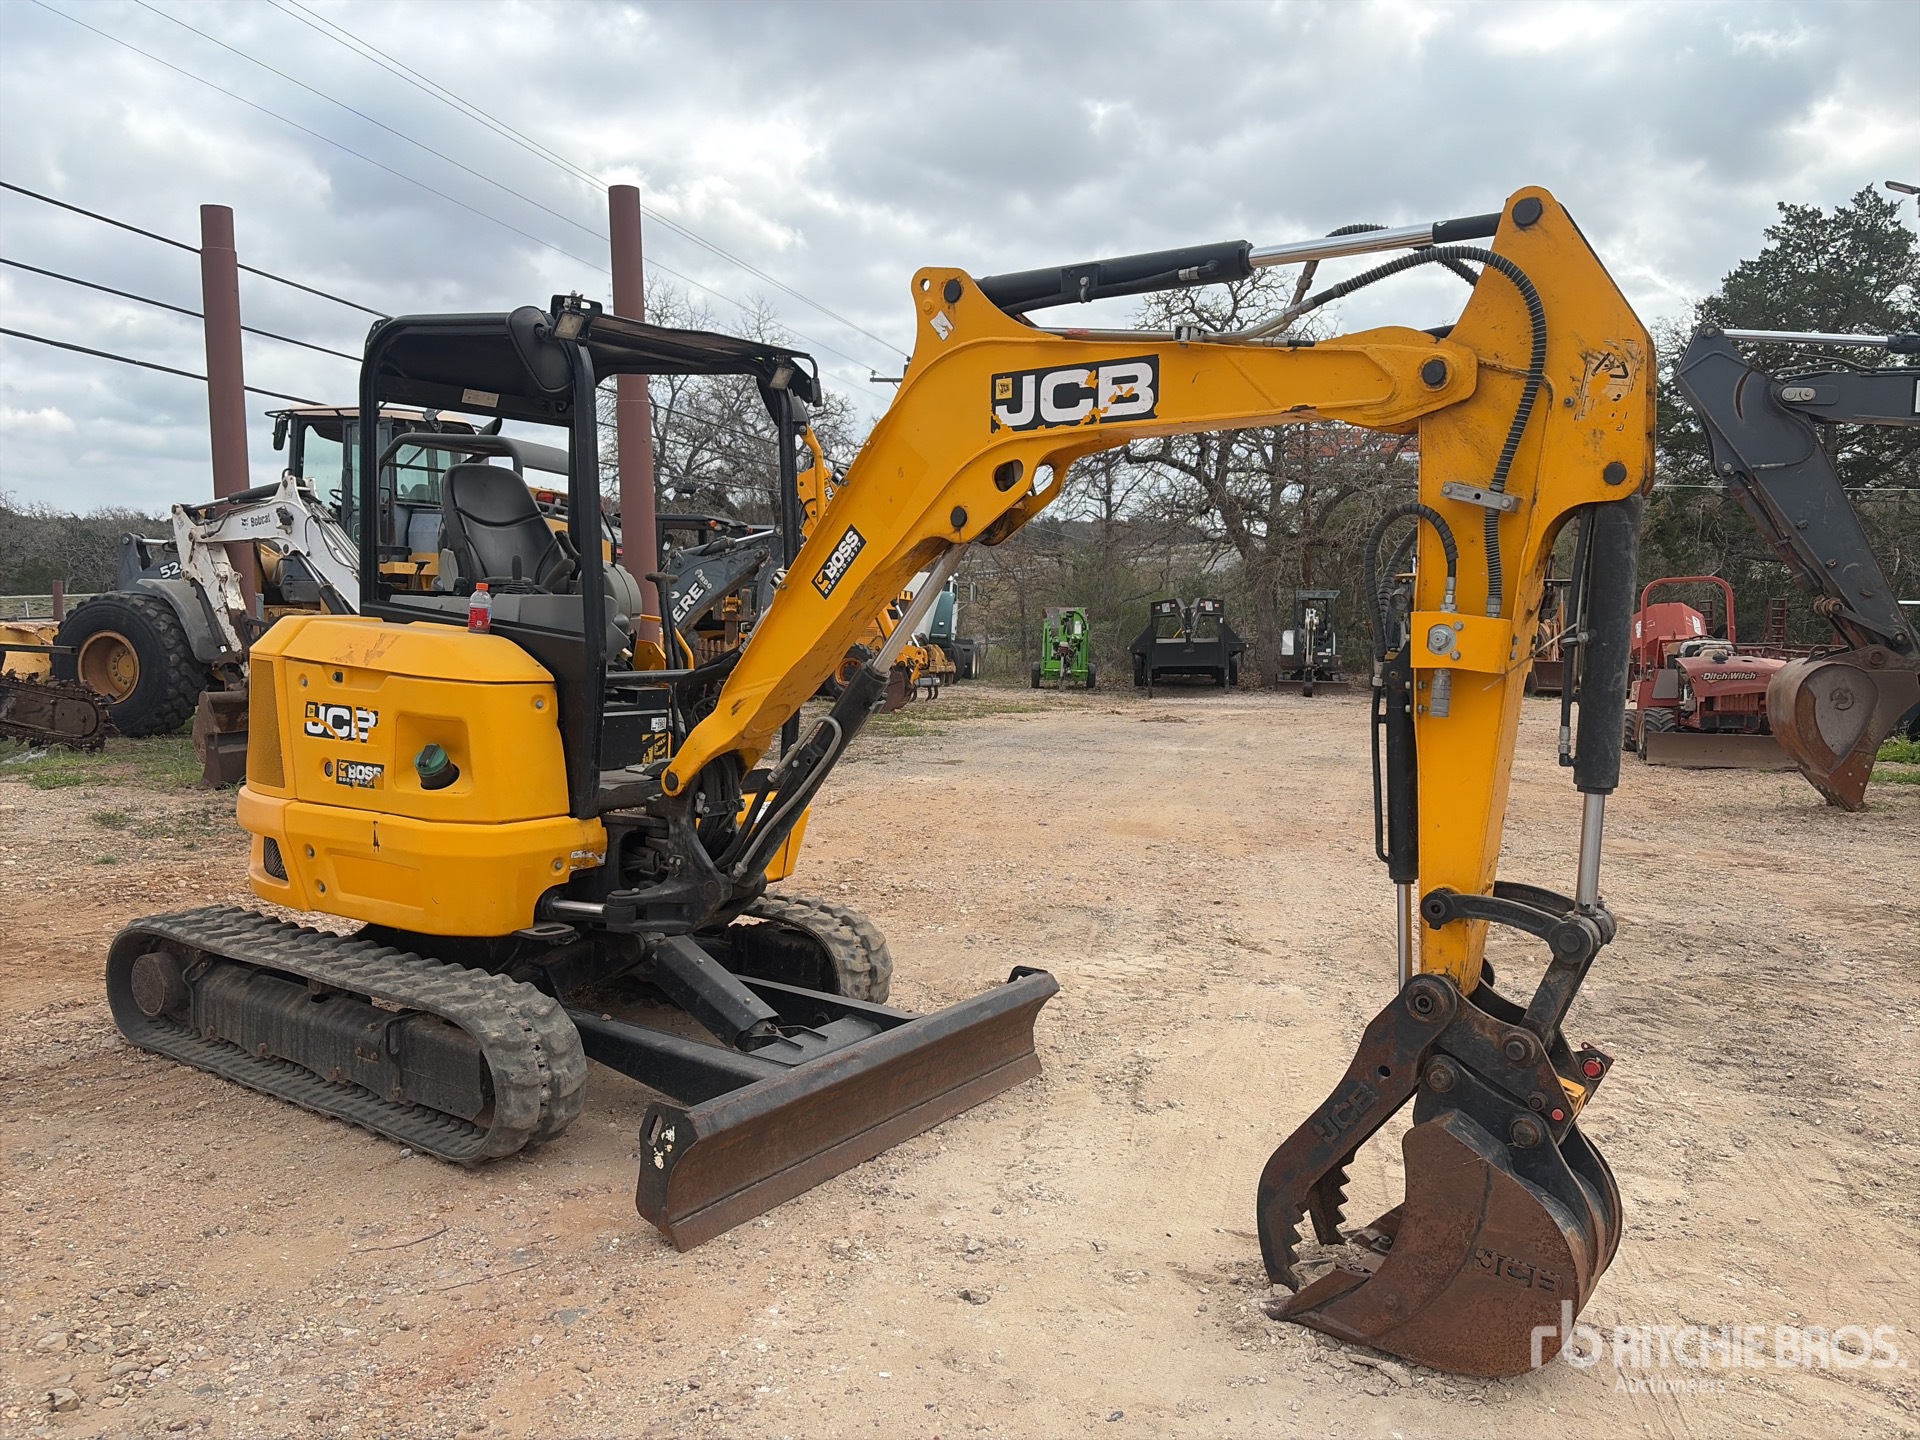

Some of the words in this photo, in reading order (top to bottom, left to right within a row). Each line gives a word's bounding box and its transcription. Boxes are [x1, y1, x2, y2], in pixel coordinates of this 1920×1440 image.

[996, 362, 1154, 427] JCB
[251, 513, 271, 527] Bobcat
[824, 530, 859, 579] BOSS
[1703, 672, 1727, 680] Ditch
[1730, 672, 1756, 680] Witch
[1313, 1082, 1376, 1143] JCB
